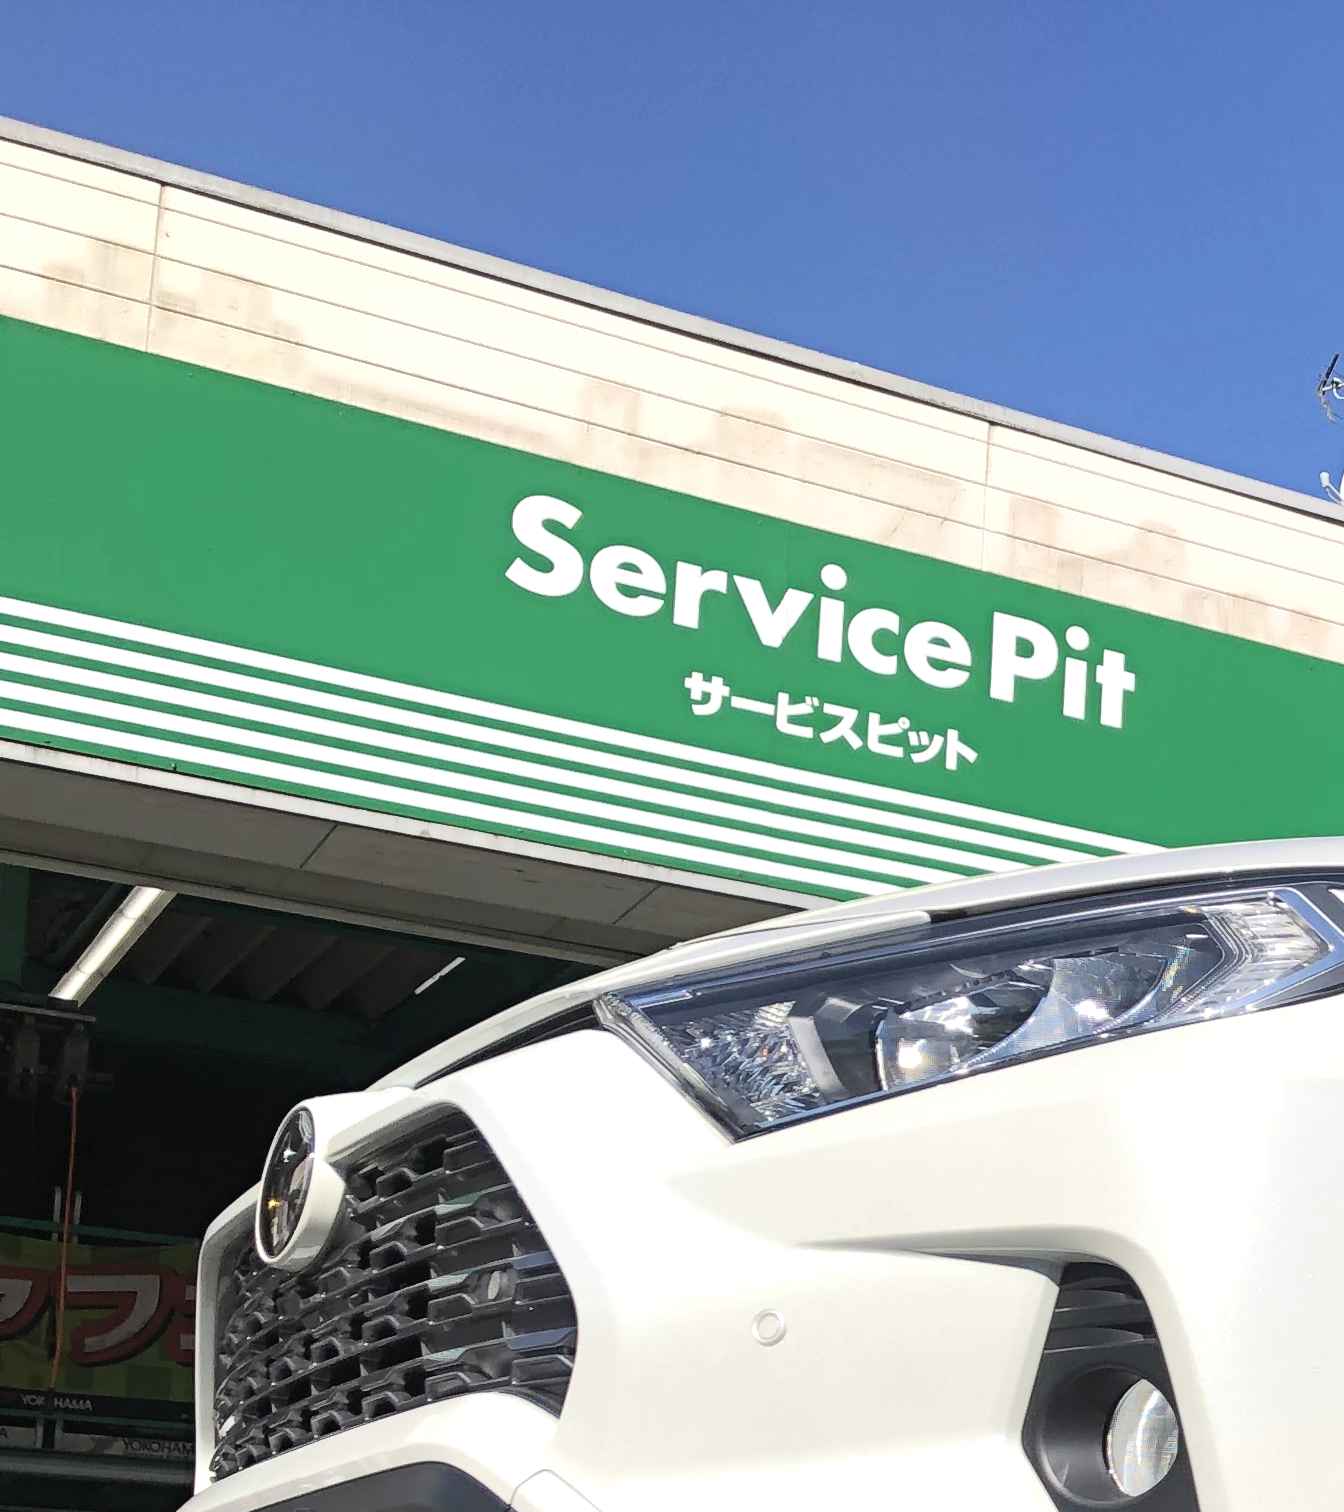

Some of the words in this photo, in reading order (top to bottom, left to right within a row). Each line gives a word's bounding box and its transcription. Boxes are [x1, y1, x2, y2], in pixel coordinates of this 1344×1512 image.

[505, 495, 972, 688] Service
[990, 610, 1136, 729] Pit
[684, 671, 978, 770] サービスピット
[20, 1394, 95, 1411] YOKHAMA
